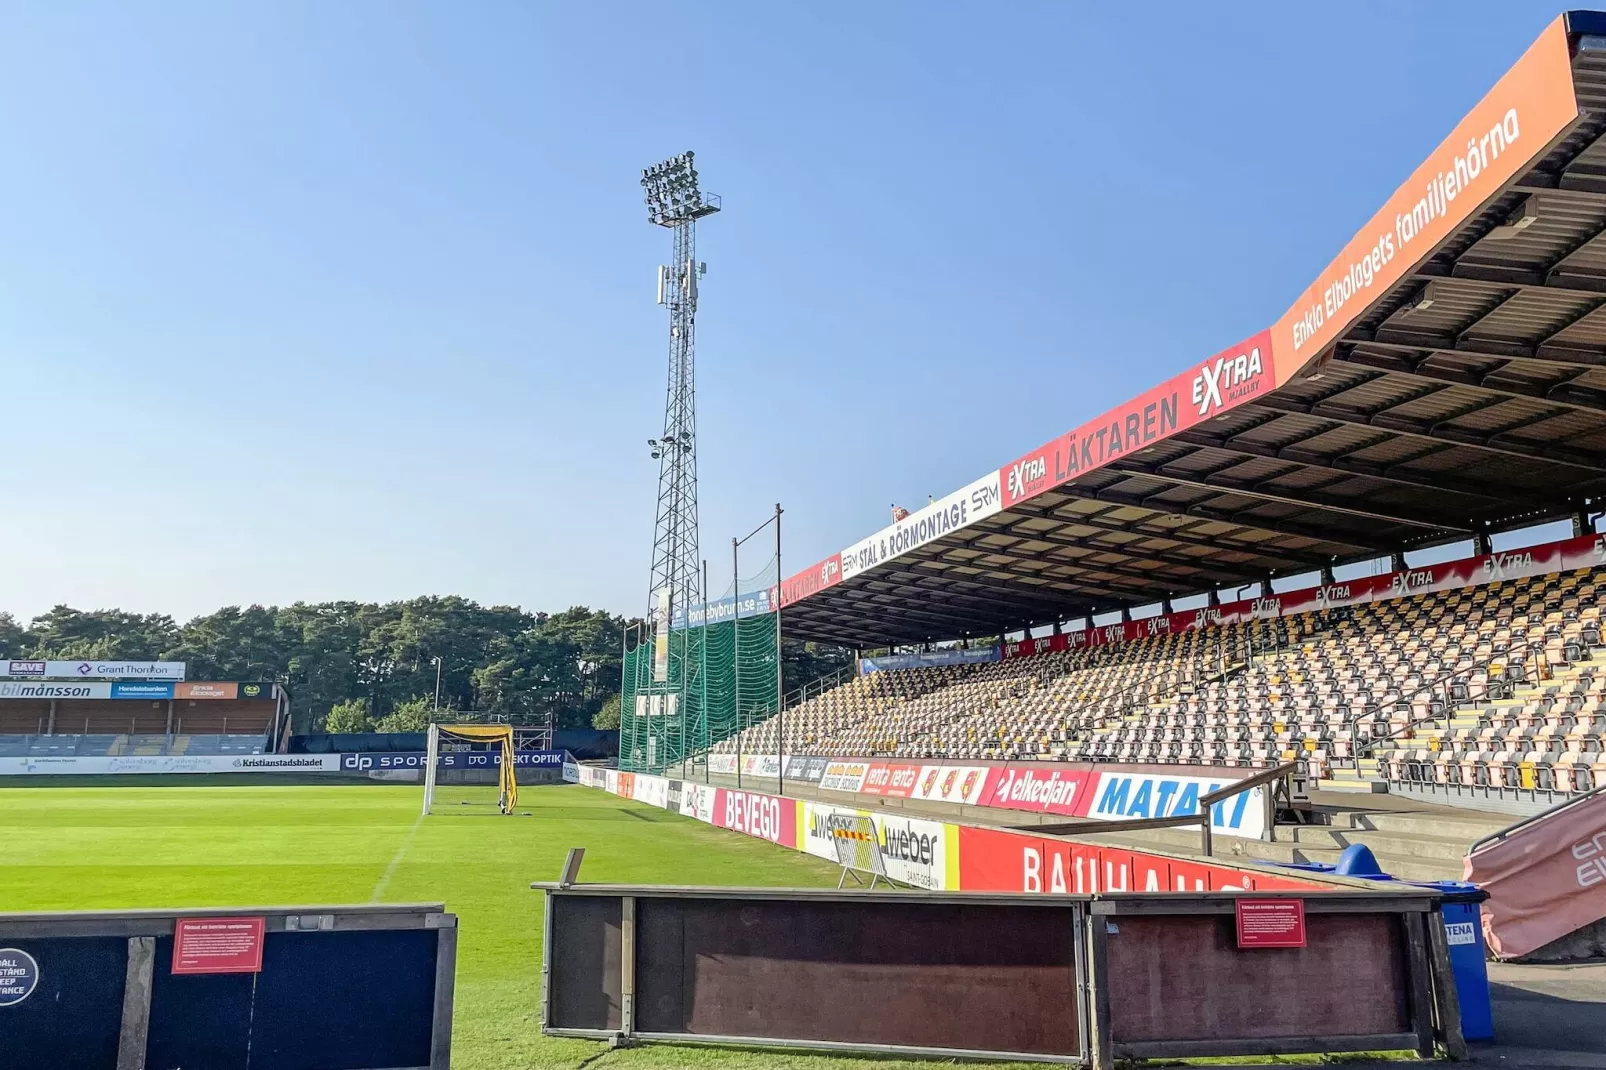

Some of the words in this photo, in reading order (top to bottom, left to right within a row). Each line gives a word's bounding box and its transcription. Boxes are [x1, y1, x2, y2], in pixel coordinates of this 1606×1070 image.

[1292, 309, 1324, 351] Enkla
[1324, 230, 1395, 320] Elbolagets
[1395, 107, 1520, 249] familjehörna
[1054, 392, 1179, 481] LÄKTAREN
[859, 540, 879, 570] STÅL
[880, 538, 888, 560] &
[889, 499, 967, 556] RÖRMONTAGE
[971, 482, 999, 513] SRM
[10, 662, 45, 672] SAVE
[97, 664, 125, 674] Grant
[1, 684, 91, 697] bilmånsson
[242, 758, 323, 767] Kristianstadsbladet
[345, 753, 373, 771] dp
[531, 754, 562, 764] OPTIK
[726, 790, 780, 842] BEVEGO
[887, 821, 938, 866] weber
[1445, 924, 1473, 936] TENA
[0, 978, 16, 986] EEP
